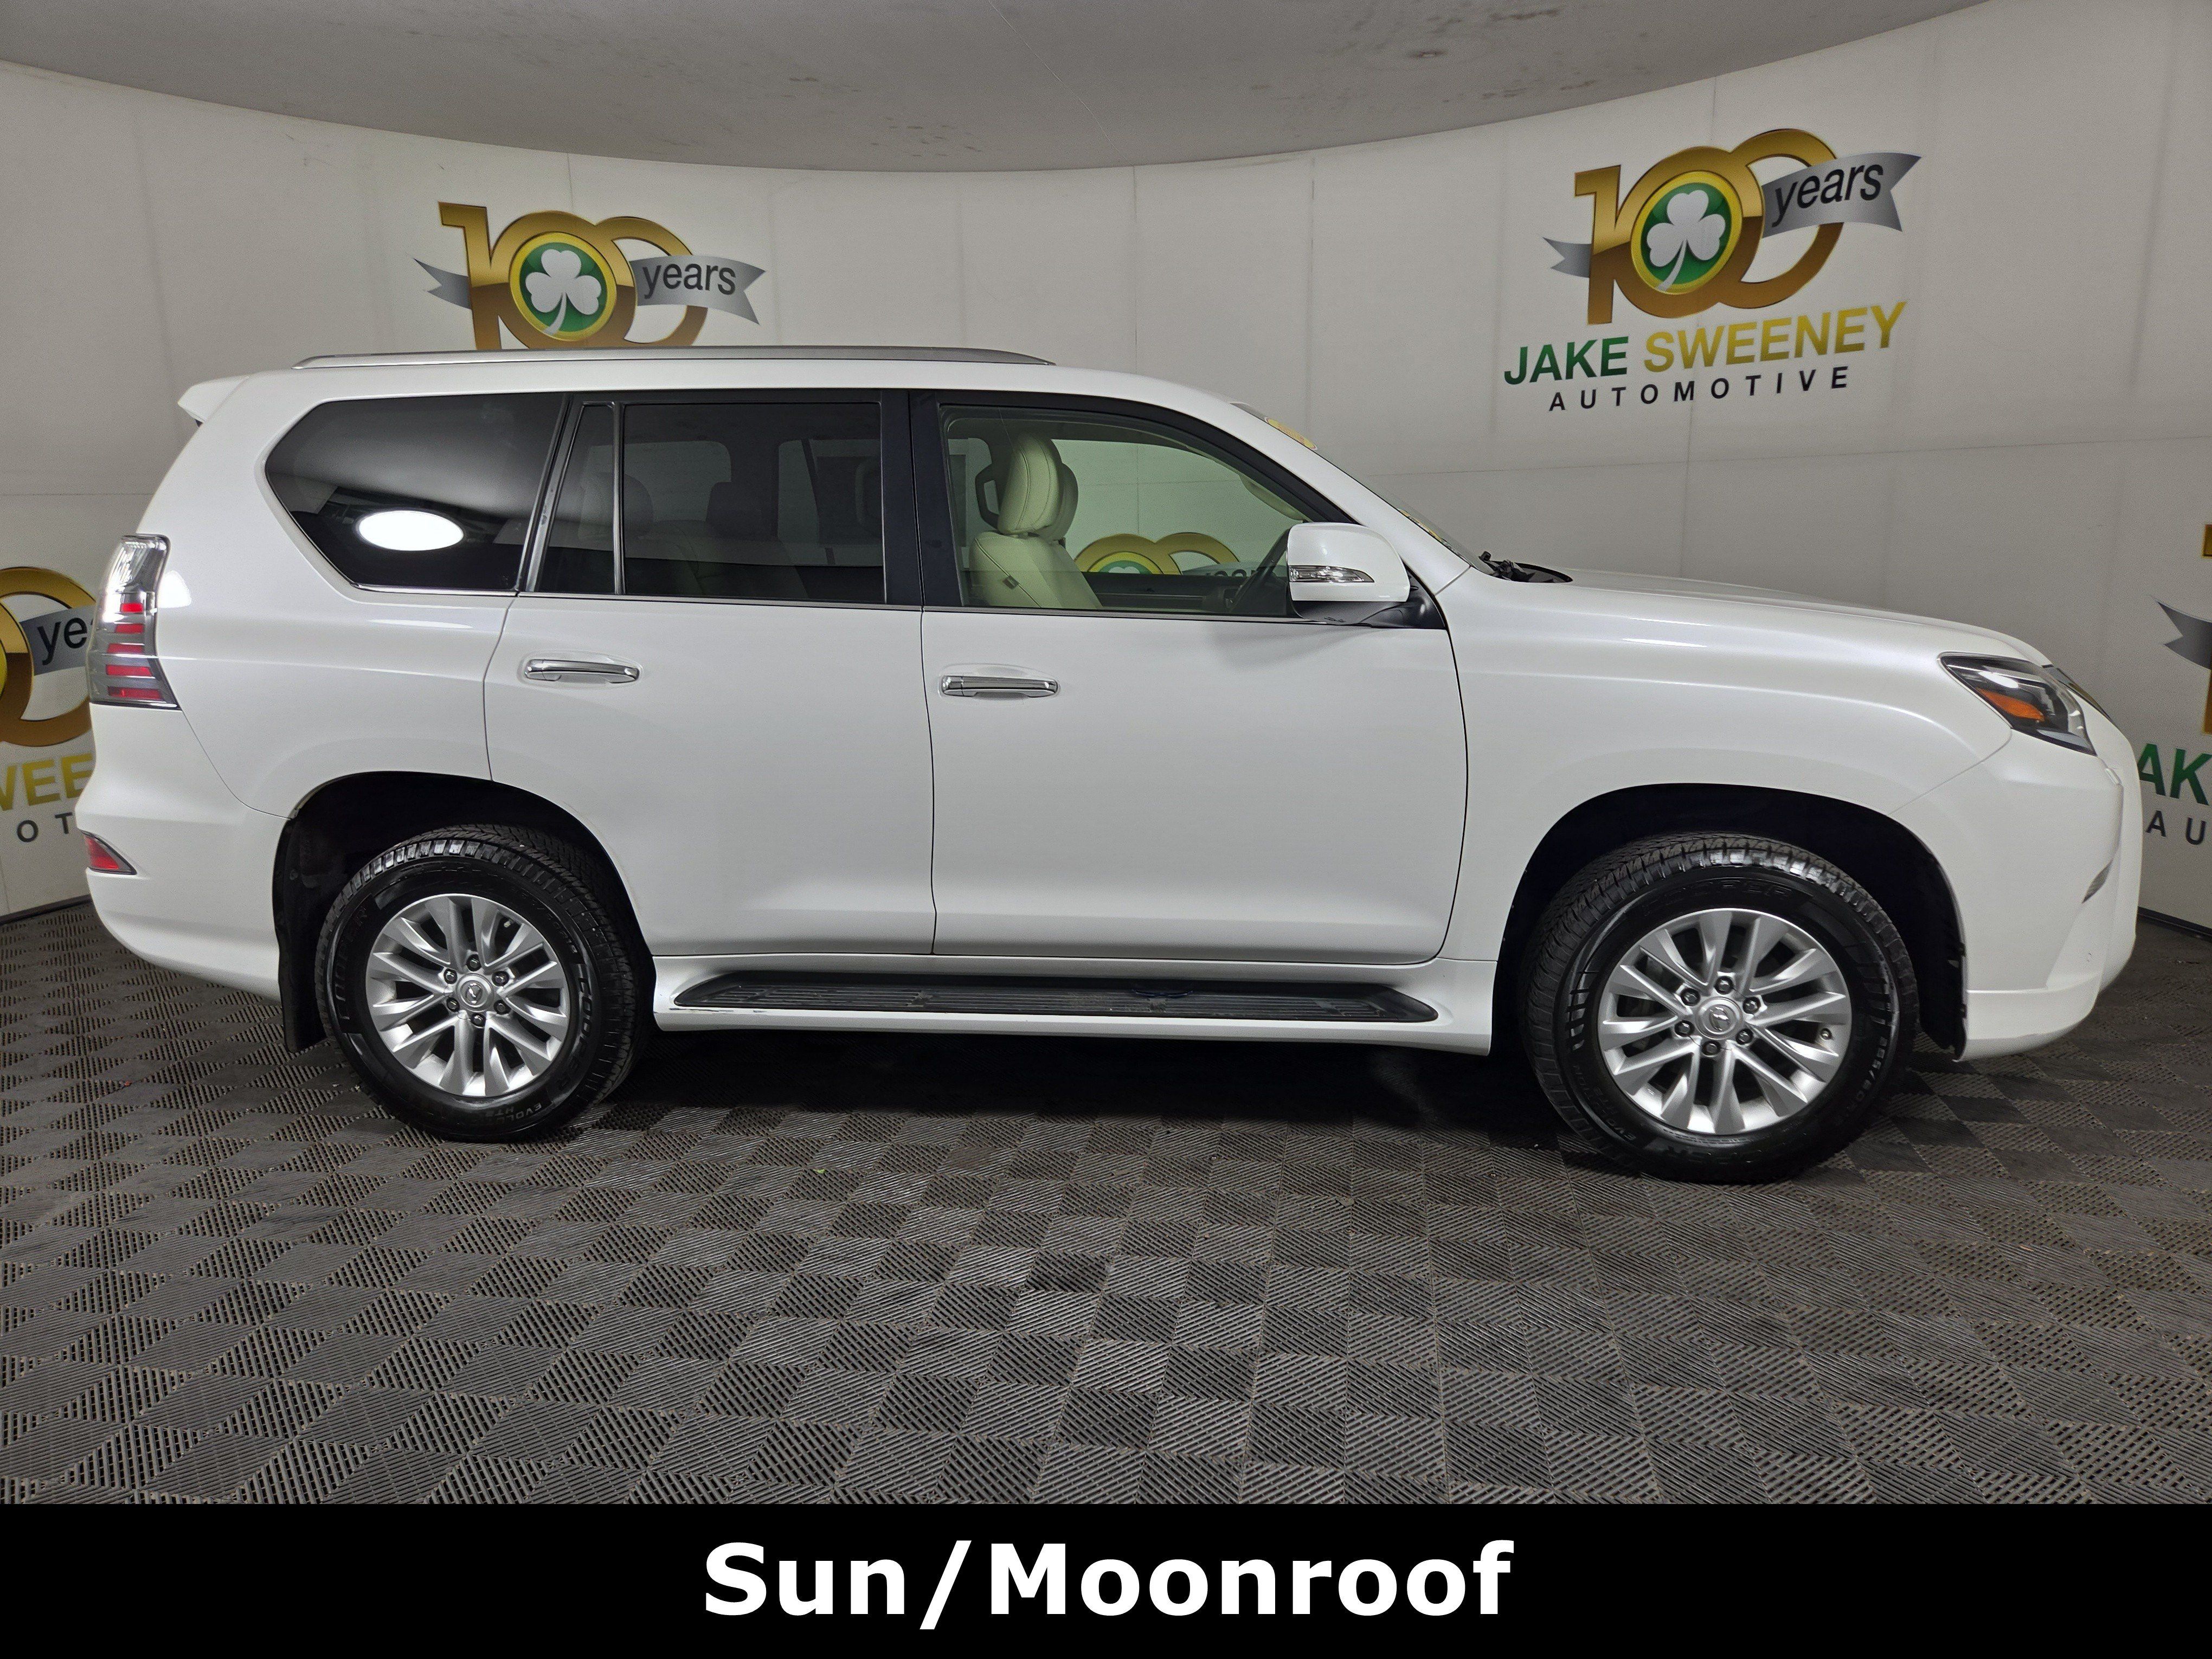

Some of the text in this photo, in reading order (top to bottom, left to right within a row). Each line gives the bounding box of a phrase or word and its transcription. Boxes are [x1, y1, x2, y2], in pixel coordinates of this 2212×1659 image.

[1574, 128, 1884, 325] 100 years
[641, 263, 737, 299] years
[1504, 301, 1907, 385] JAKE SWEENEY
[1548, 365, 1849, 411] AUTOMOTIVE
